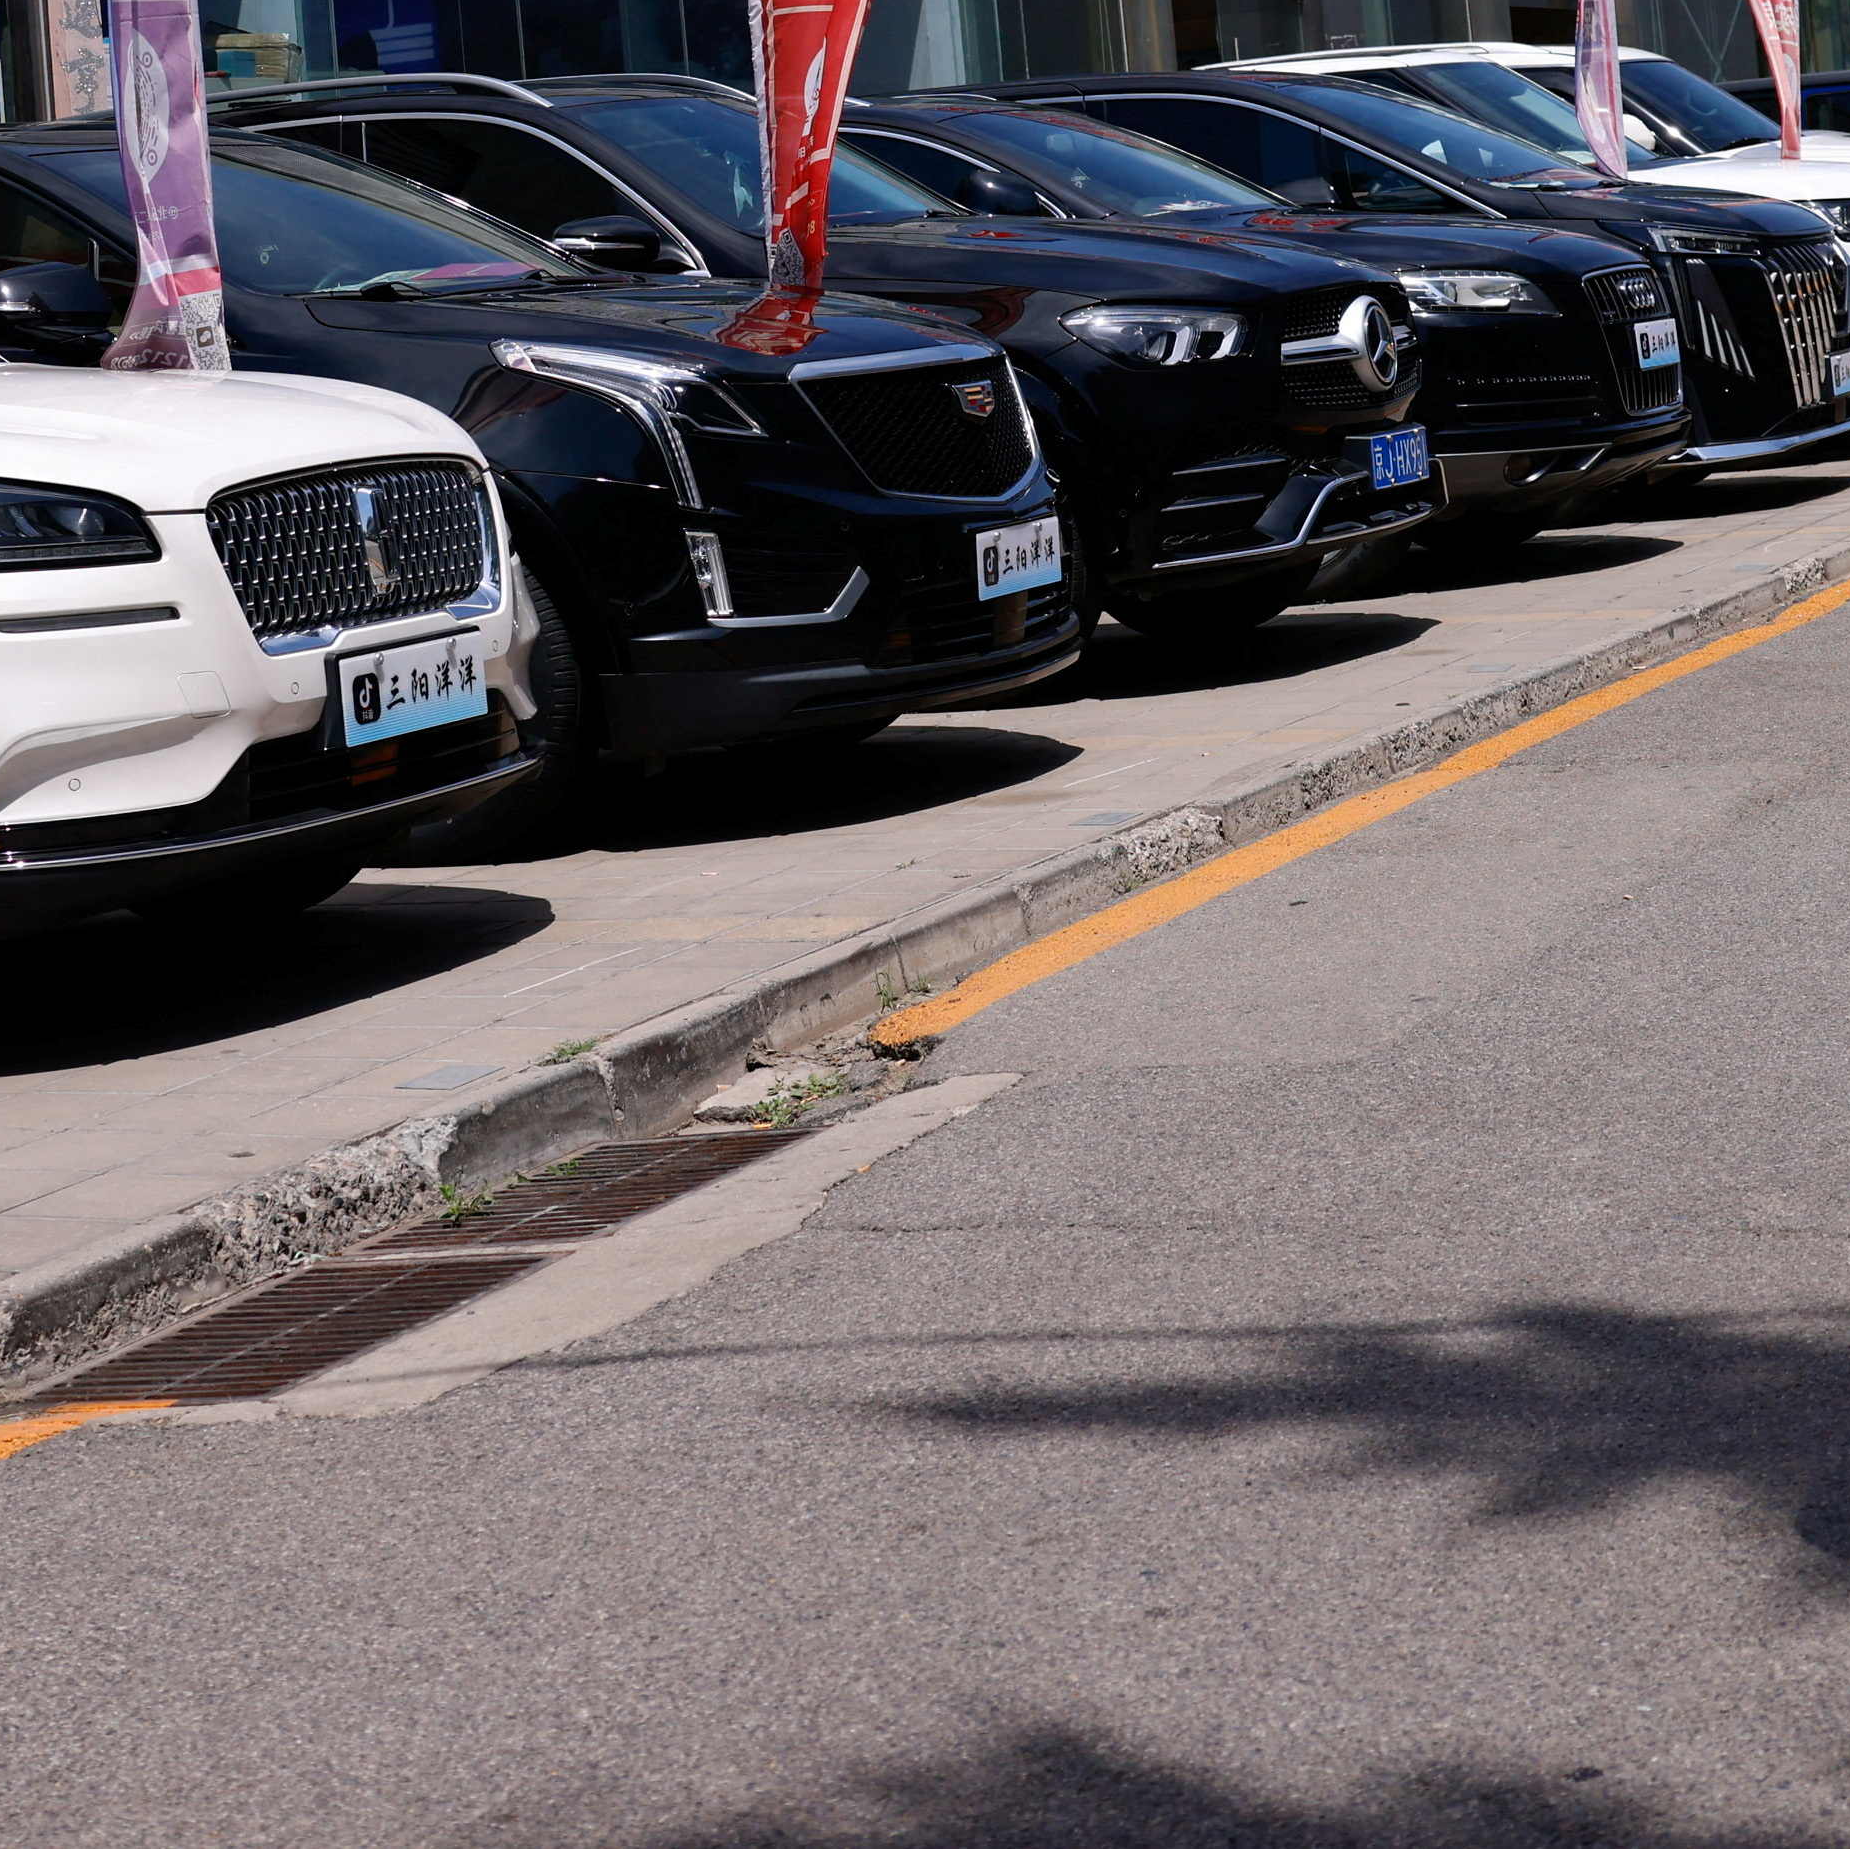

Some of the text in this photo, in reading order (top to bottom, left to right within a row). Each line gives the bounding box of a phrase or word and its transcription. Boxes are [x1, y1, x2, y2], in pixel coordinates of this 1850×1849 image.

[1001, 536, 1056, 576] 三阳洋洋
[386, 654, 477, 710] 三阳洋洋
